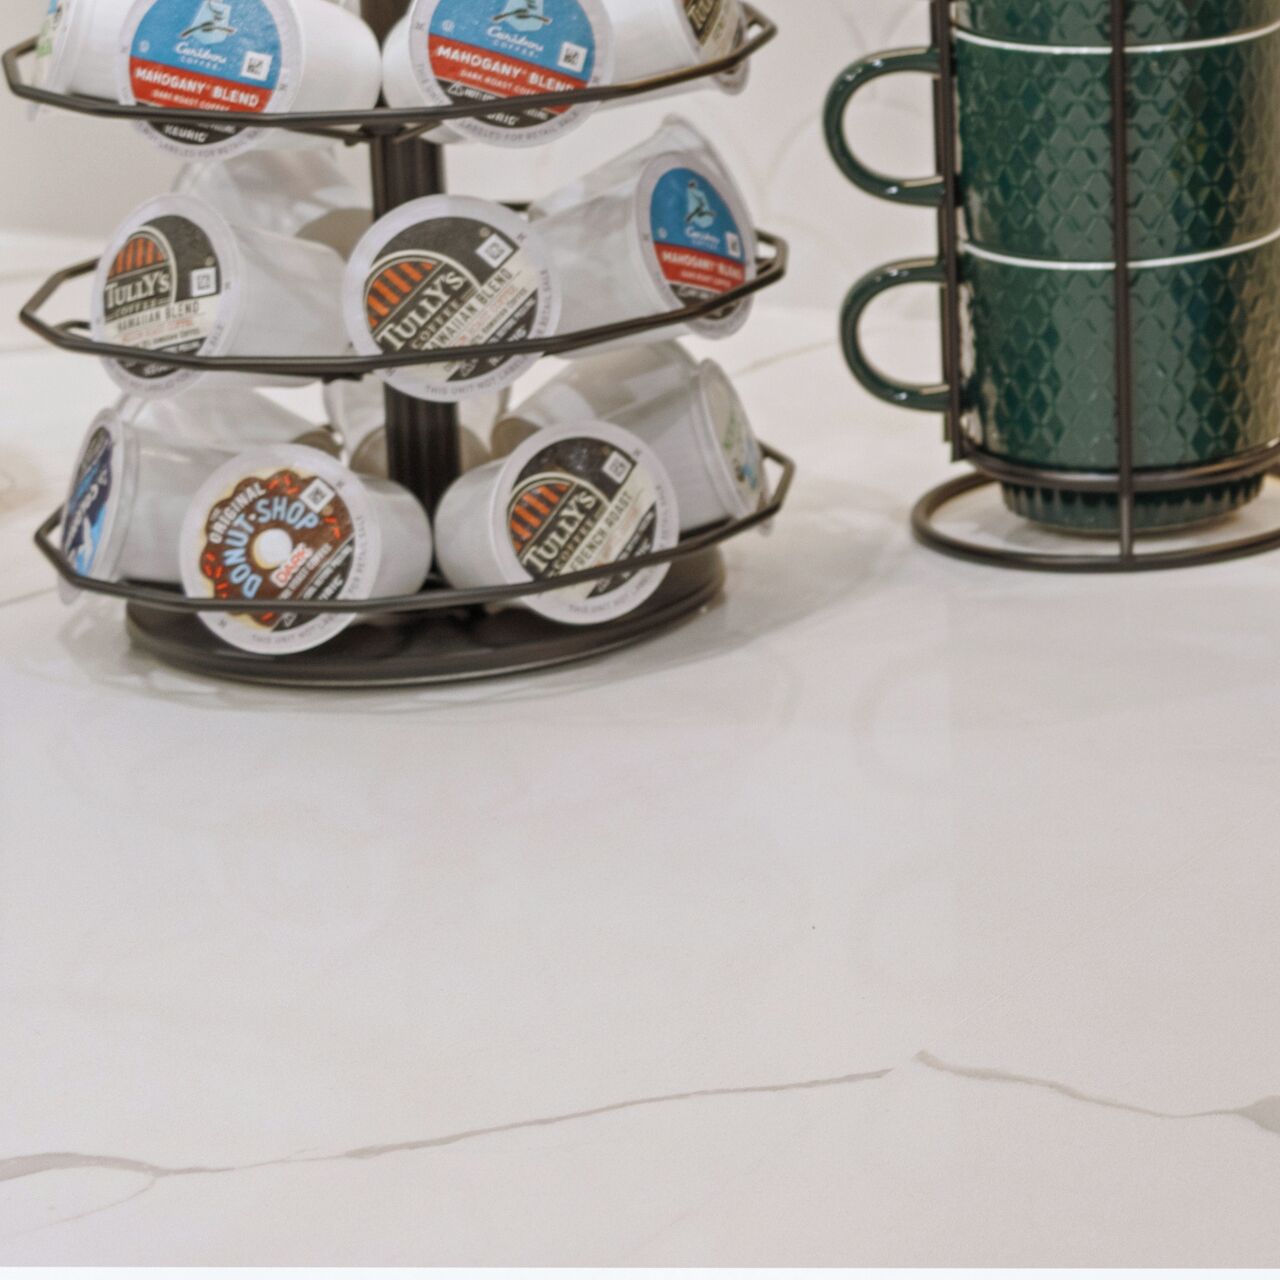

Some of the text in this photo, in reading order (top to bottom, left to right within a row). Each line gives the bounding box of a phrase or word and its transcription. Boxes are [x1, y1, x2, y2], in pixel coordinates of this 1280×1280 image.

[436, 45, 523, 76] MAHOGANY
[135, 67, 259, 108] MAHOGANY BLEND
[375, 270, 466, 351] TULLY'S
[476, 268, 513, 306] BLEND
[208, 482, 267, 544] ORIGINAL
[522, 491, 597, 570] TULLY'S
[607, 491, 633, 530] ROAST
[223, 513, 263, 598] DONUT
[255, 496, 319, 529] SHOP
